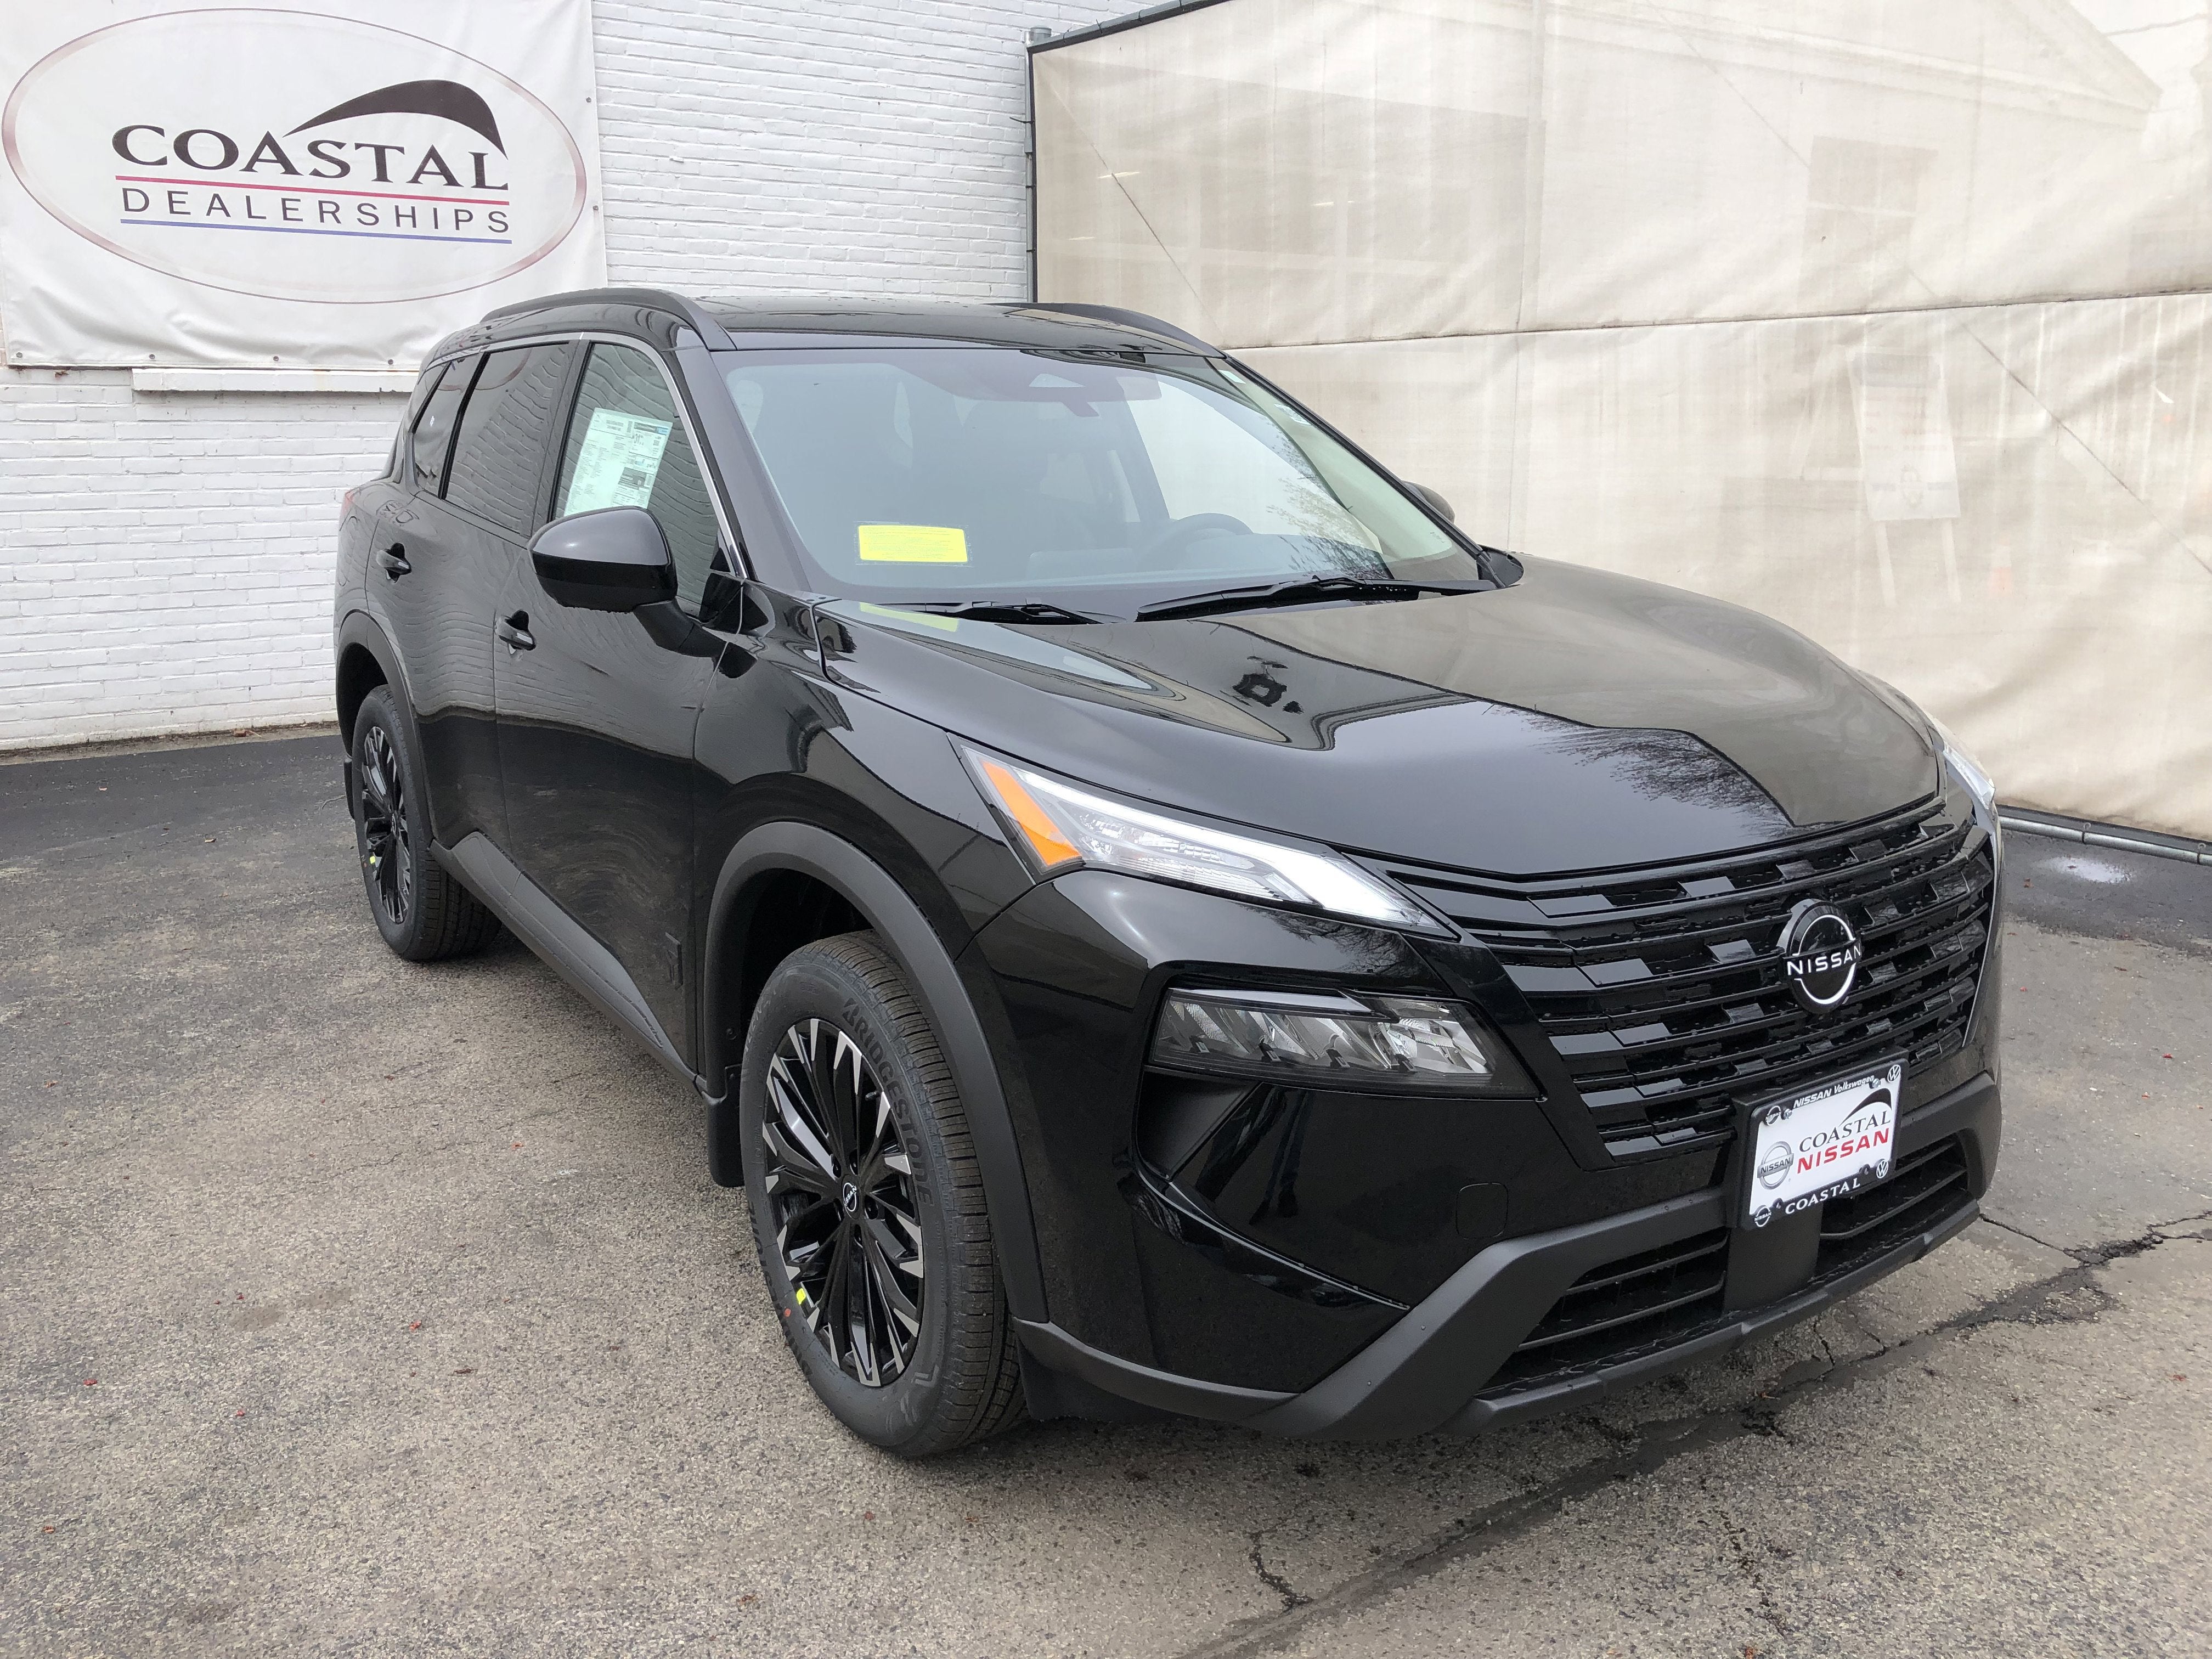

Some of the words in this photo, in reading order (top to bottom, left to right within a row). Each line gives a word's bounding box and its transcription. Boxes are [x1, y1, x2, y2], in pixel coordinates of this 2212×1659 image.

[112, 125, 509, 191] COASTAL
[122, 188, 510, 234] DEALERSHIPS
[1787, 942, 1861, 975] NISSAN
[842, 997, 934, 1205] BRIDGESTONE
[1793, 1088, 1832, 1108] NISSAN
[1834, 1075, 1875, 1094] Volkswagen
[1797, 1128, 1889, 1174] NISSAN
[1799, 1110, 1891, 1152] COASTAL
[1760, 1156, 1791, 1175] NISSAN
[1785, 1178, 1860, 1214] COASTAL
